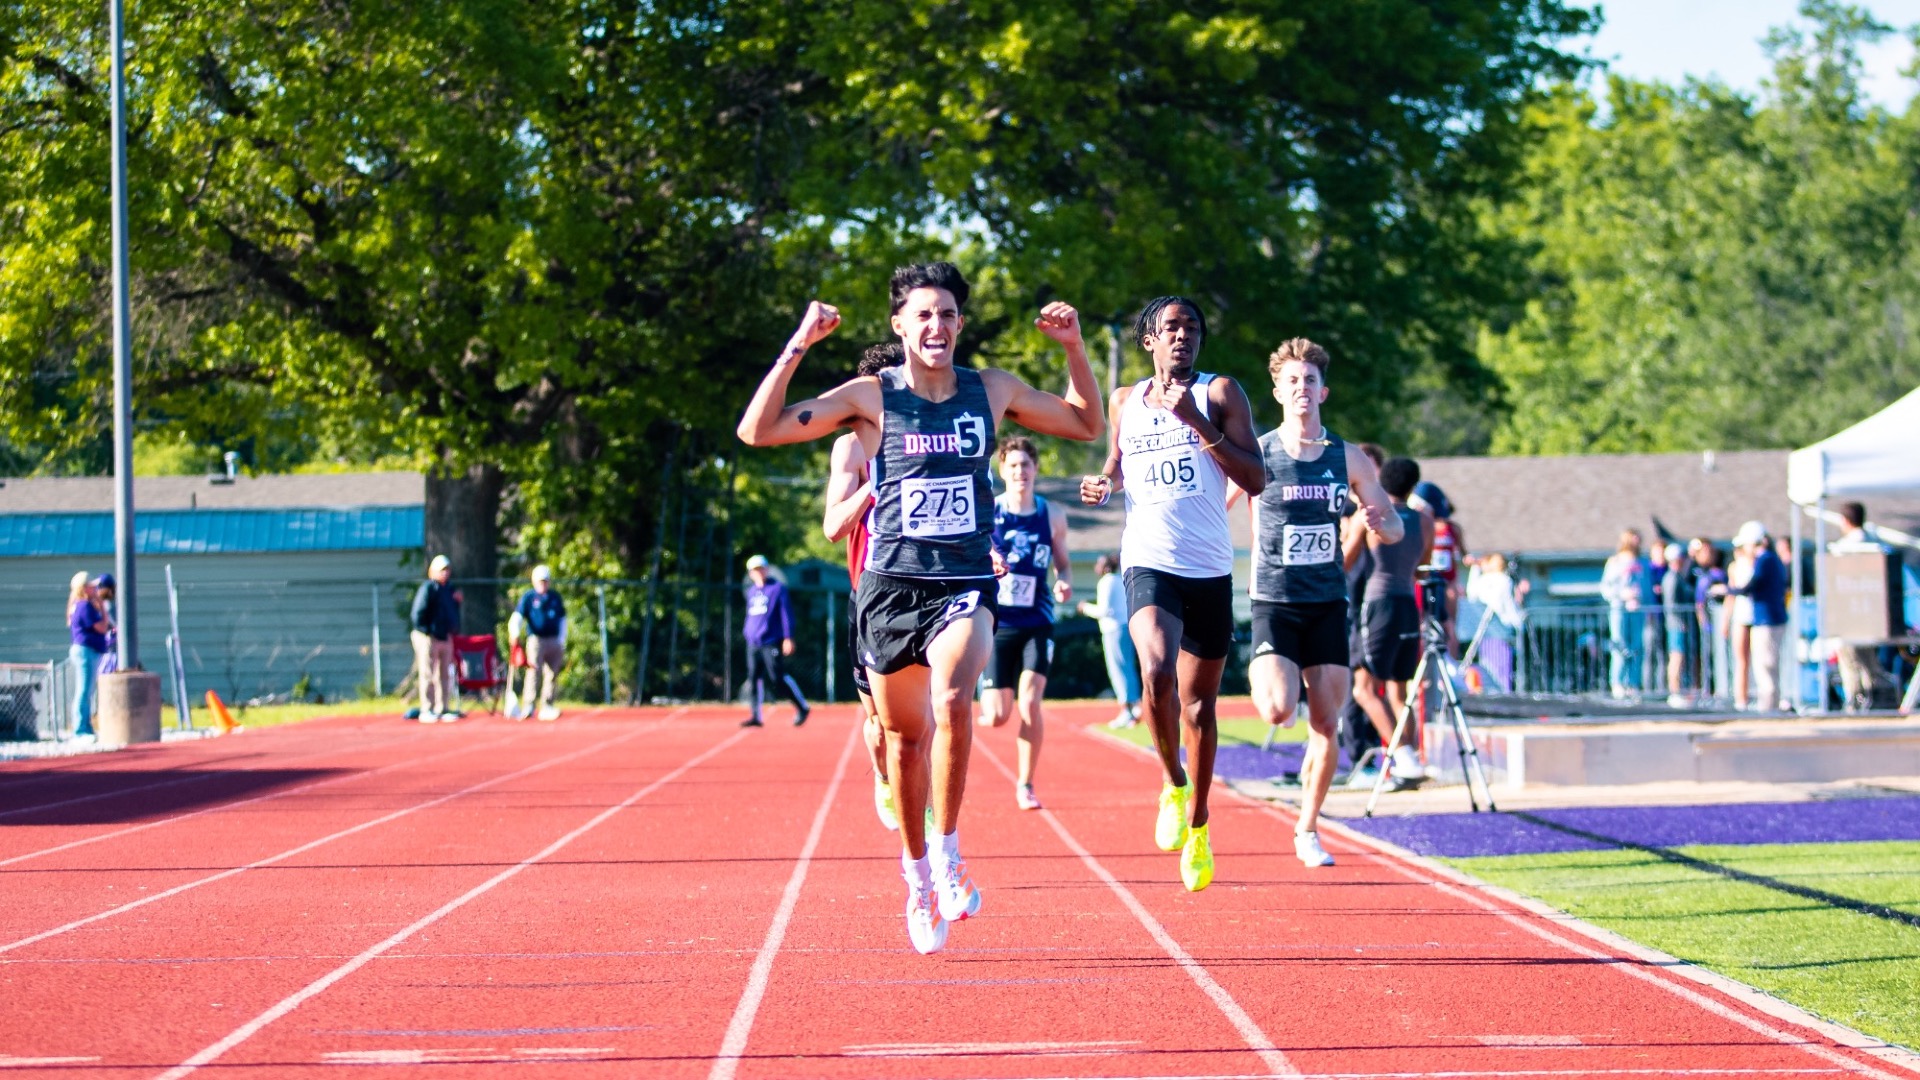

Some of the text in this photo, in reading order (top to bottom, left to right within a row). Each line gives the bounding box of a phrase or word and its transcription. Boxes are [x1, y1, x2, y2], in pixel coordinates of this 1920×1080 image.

[958, 420, 980, 456] 5
[1145, 457, 1195, 487] 405
[909, 487, 969, 518] 275
[1334, 484, 1347, 511] 6
[1289, 531, 1331, 552] 276
[1036, 545, 1047, 567] 2
